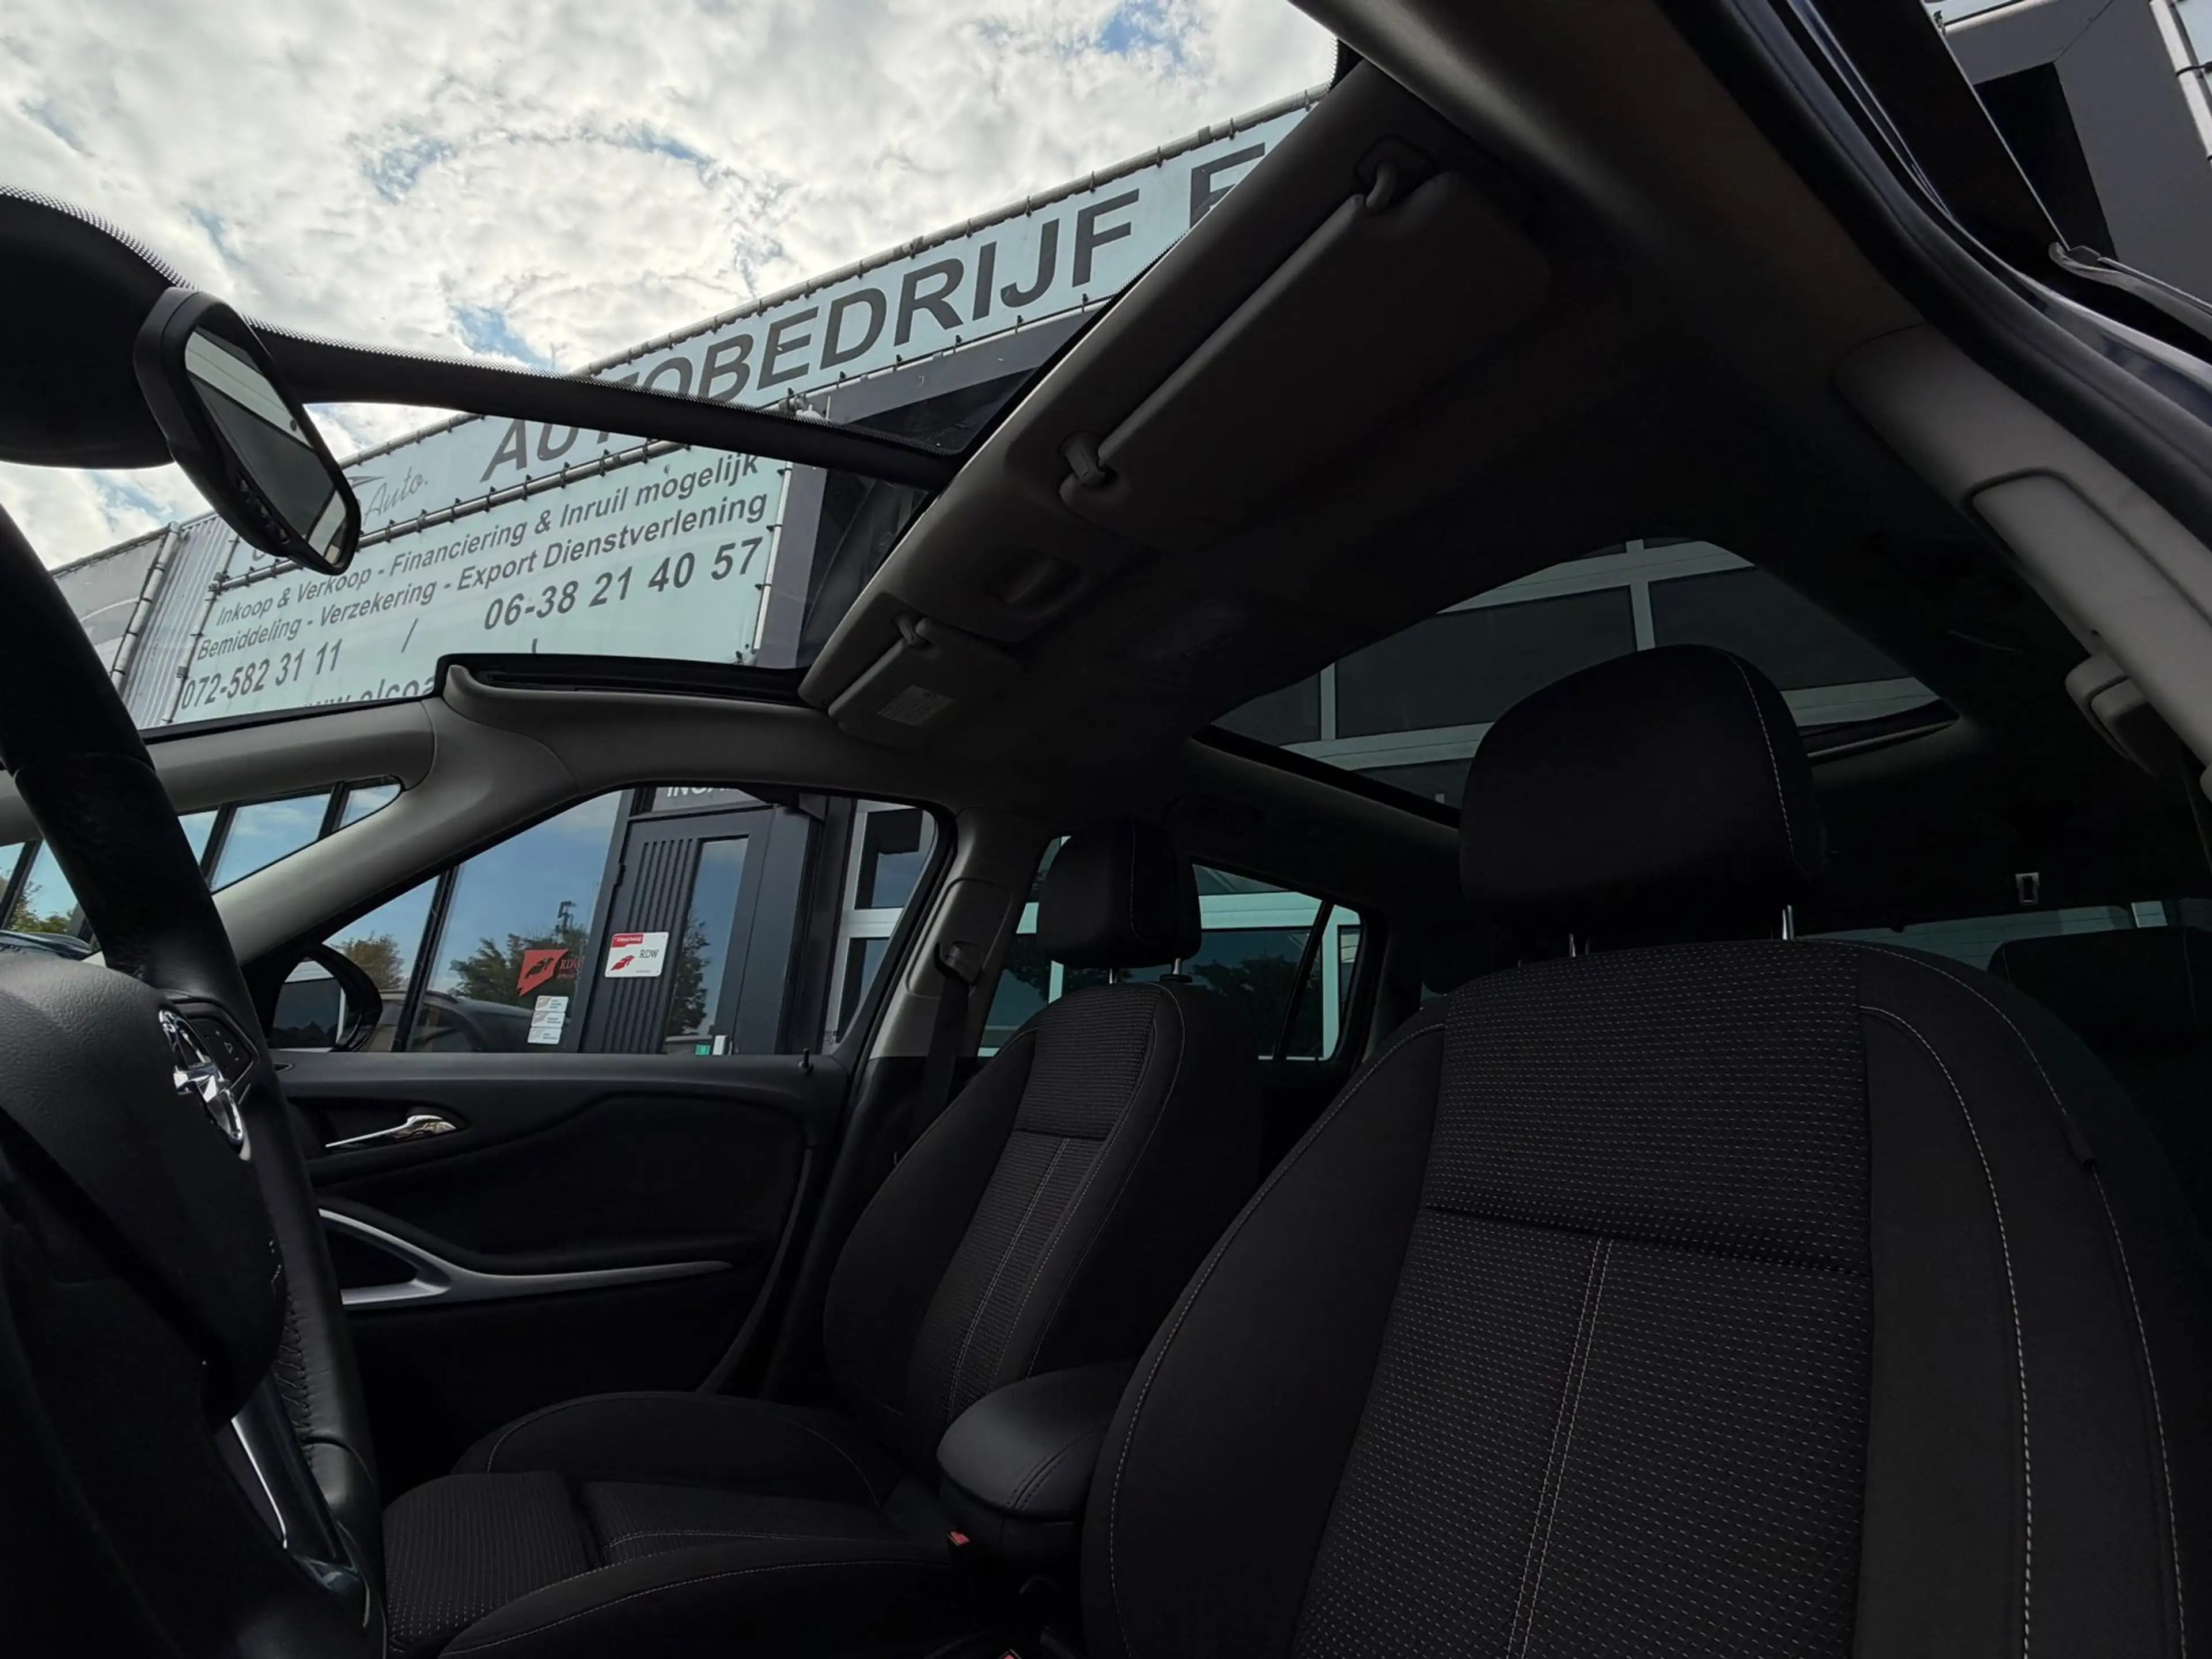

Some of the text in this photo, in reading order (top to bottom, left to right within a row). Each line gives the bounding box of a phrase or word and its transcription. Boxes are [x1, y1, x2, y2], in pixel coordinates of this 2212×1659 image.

[181, 658, 270, 710] 072-582
[275, 648, 305, 686] 31
[316, 638, 342, 675] 11
[484, 580, 578, 630] 06-38
[589, 566, 632, 607] 21
[648, 552, 695, 592] 40
[711, 537, 763, 580] 57
[197, 616, 302, 660] Bemiddeling
[321, 581, 437, 627] Verzekering
[457, 549, 537, 590] Export
[543, 493, 767, 568] Dienstverlening
[217, 597, 273, 626] Inkoop
[276, 588, 291, 606] &
[298, 568, 372, 603] Verkoop
[390, 522, 528, 576] Financiering
[535, 510, 551, 535] &
[560, 486, 628, 527] Inruil
[635, 454, 759, 506] mogelijk
[639, 949, 659, 959] RDW
